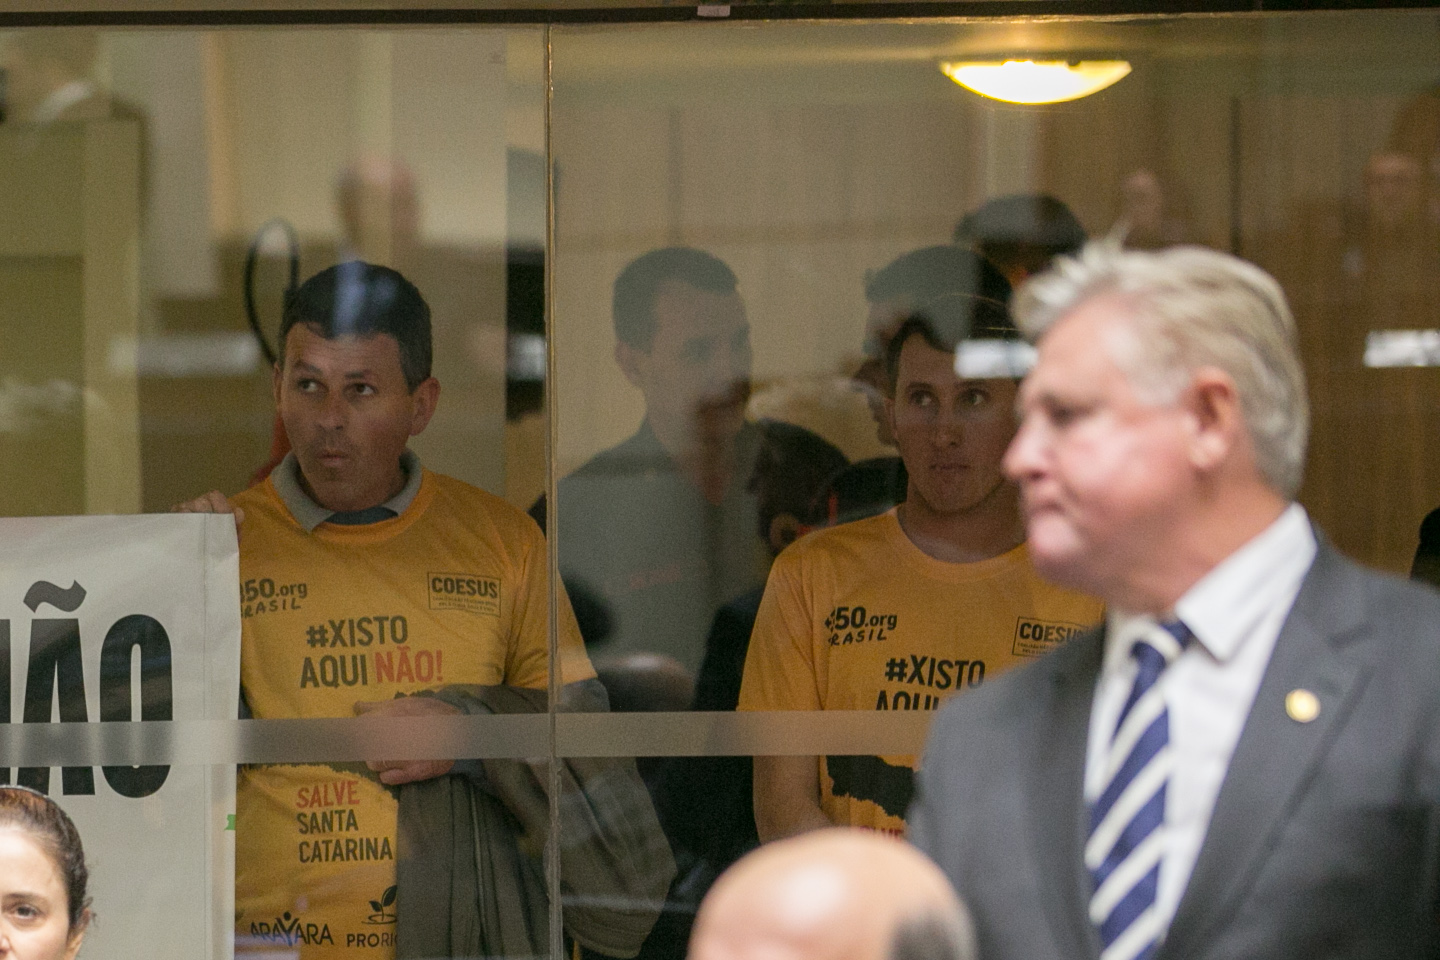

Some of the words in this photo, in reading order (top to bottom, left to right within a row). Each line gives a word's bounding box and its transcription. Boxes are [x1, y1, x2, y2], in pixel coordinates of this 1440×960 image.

[431, 577, 498, 599] COESUS
[241, 597, 302, 618] RASIL
[306, 615, 409, 648] #XISTO
[828, 629, 887, 646] RASIL
[1020, 622, 1085, 643] COESU
[300, 654, 369, 689] AQUI
[374, 645, 444, 684] NÃO!
[885, 654, 986, 691] #XISTO
[296, 780, 360, 808] SALVE
[297, 808, 359, 834] SANTA
[299, 836, 394, 863] CATARINA
[346, 932, 397, 948] PRORI
